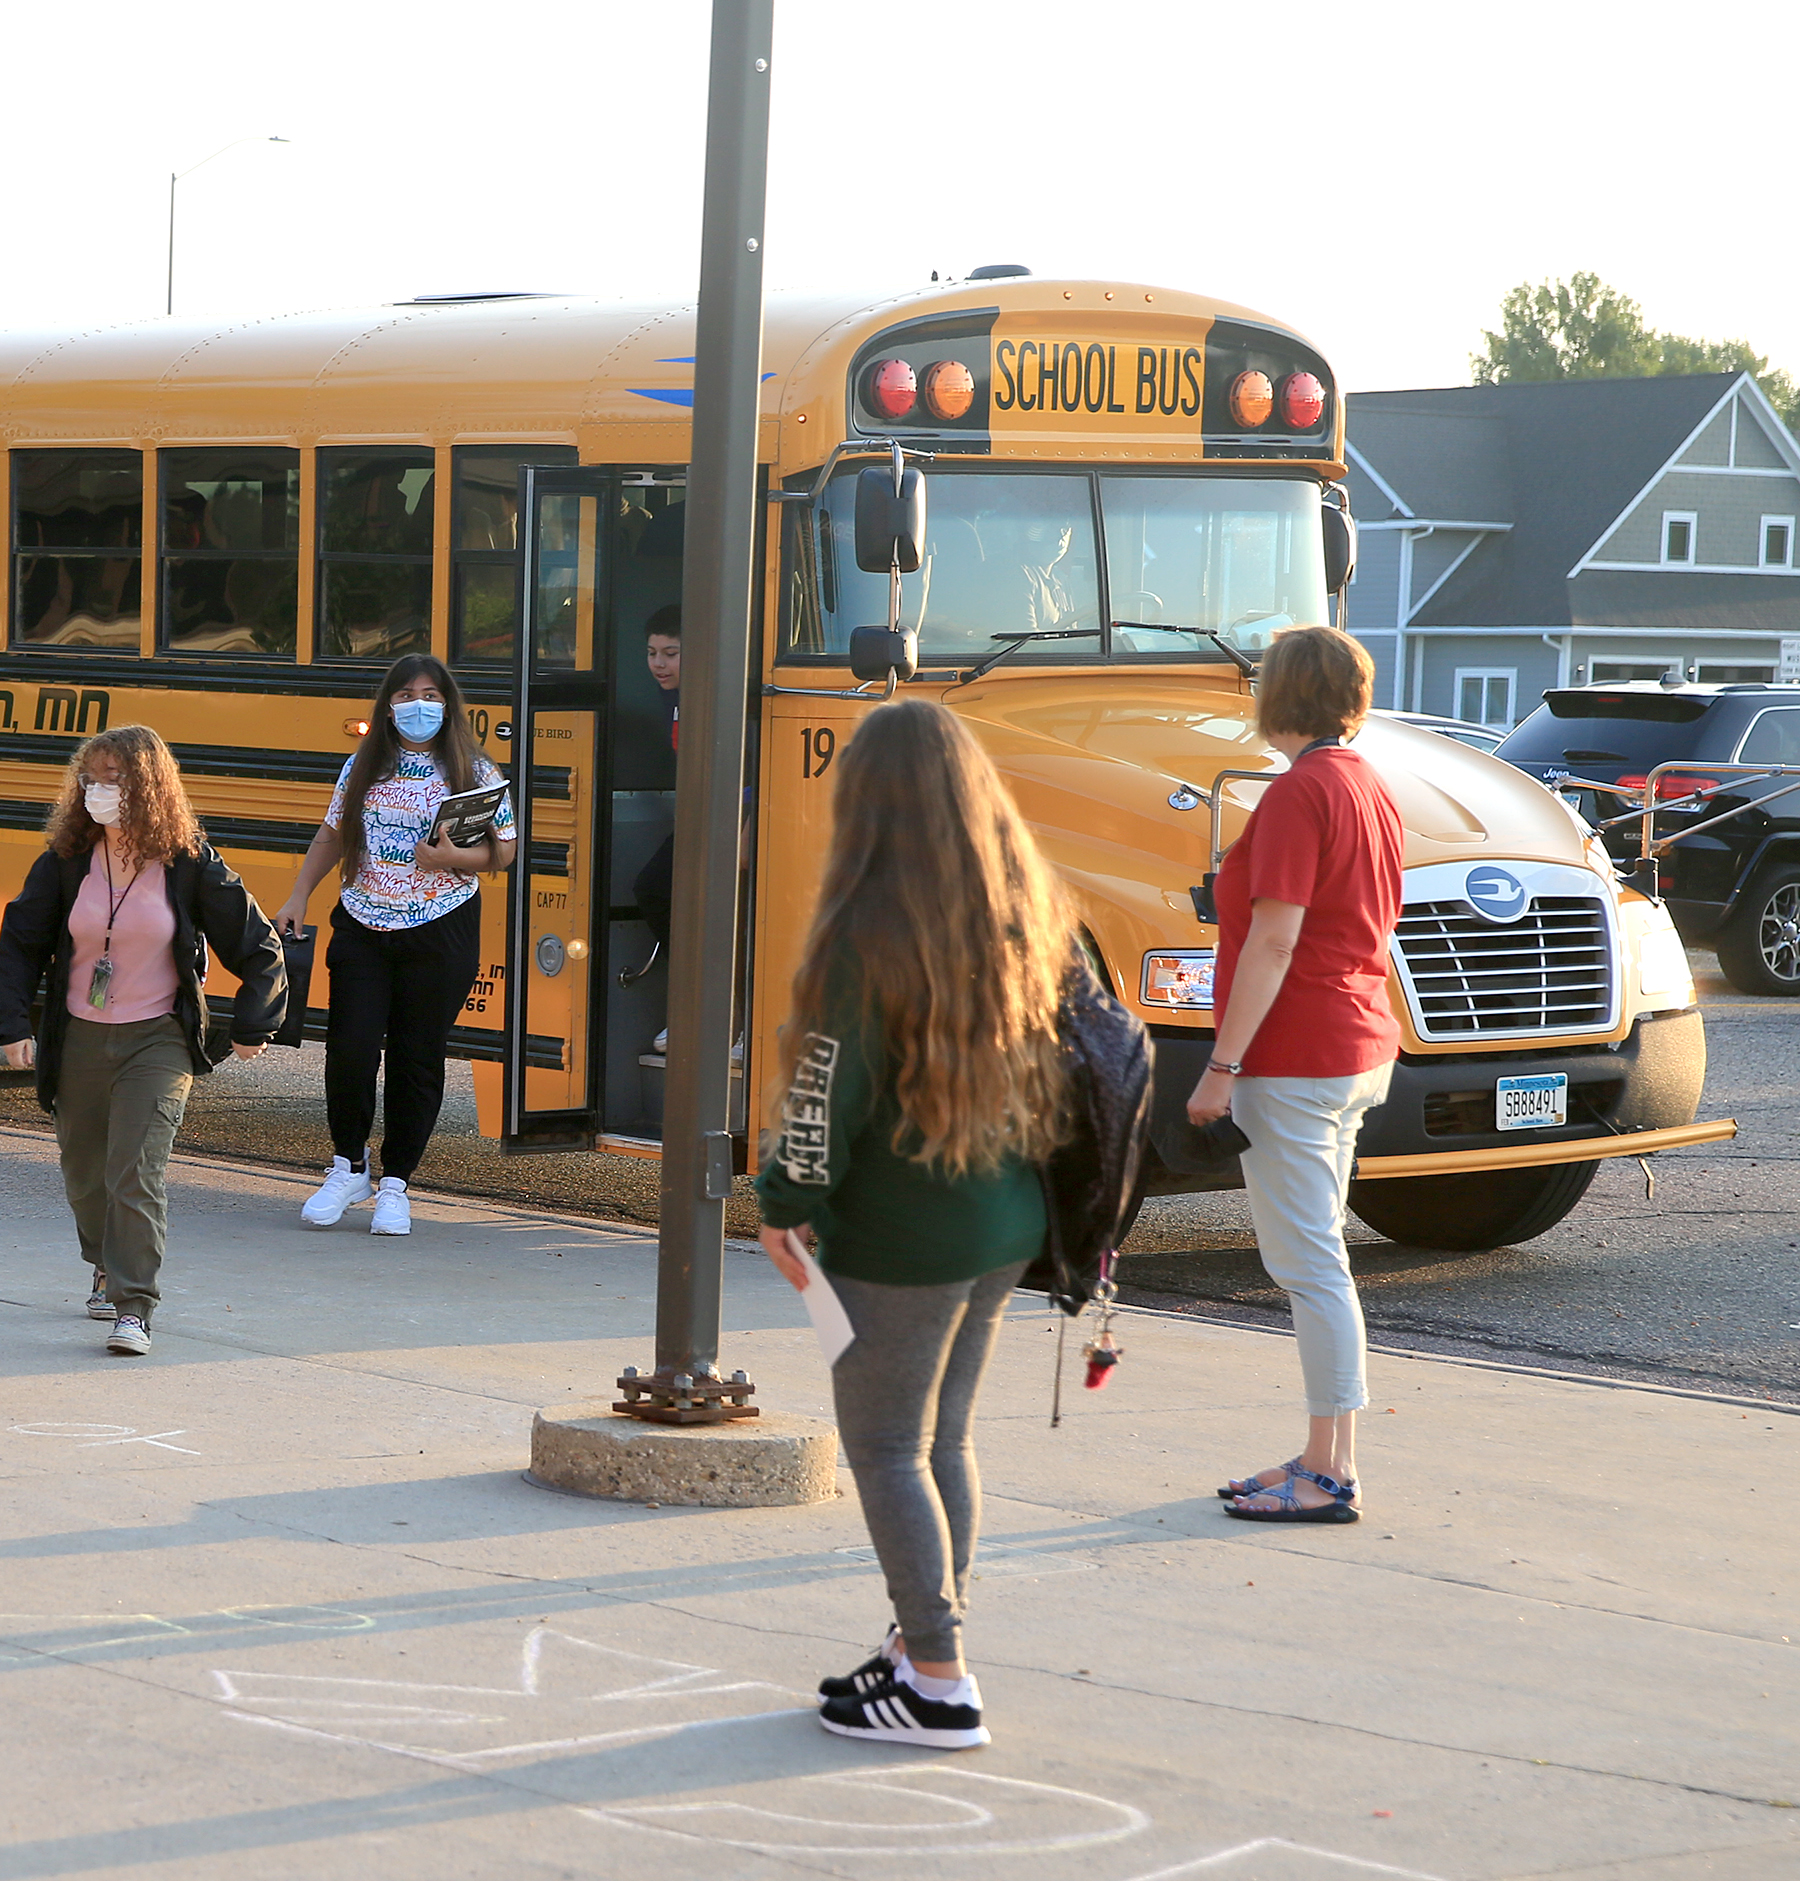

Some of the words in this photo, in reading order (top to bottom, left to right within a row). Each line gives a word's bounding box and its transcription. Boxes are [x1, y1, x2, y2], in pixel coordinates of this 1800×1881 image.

[995, 339, 1125, 413] SCHOOL
[1135, 346, 1201, 417] BUS
[33, 686, 111, 734] MN
[467, 709, 489, 747] 19
[545, 728, 573, 740] BIRD
[800, 727, 835, 778] 19
[1542, 767, 1570, 779] Jeep
[536, 892, 554, 909] CAP
[555, 893, 567, 910] 77
[1505, 1089, 1557, 1117] SB88491
